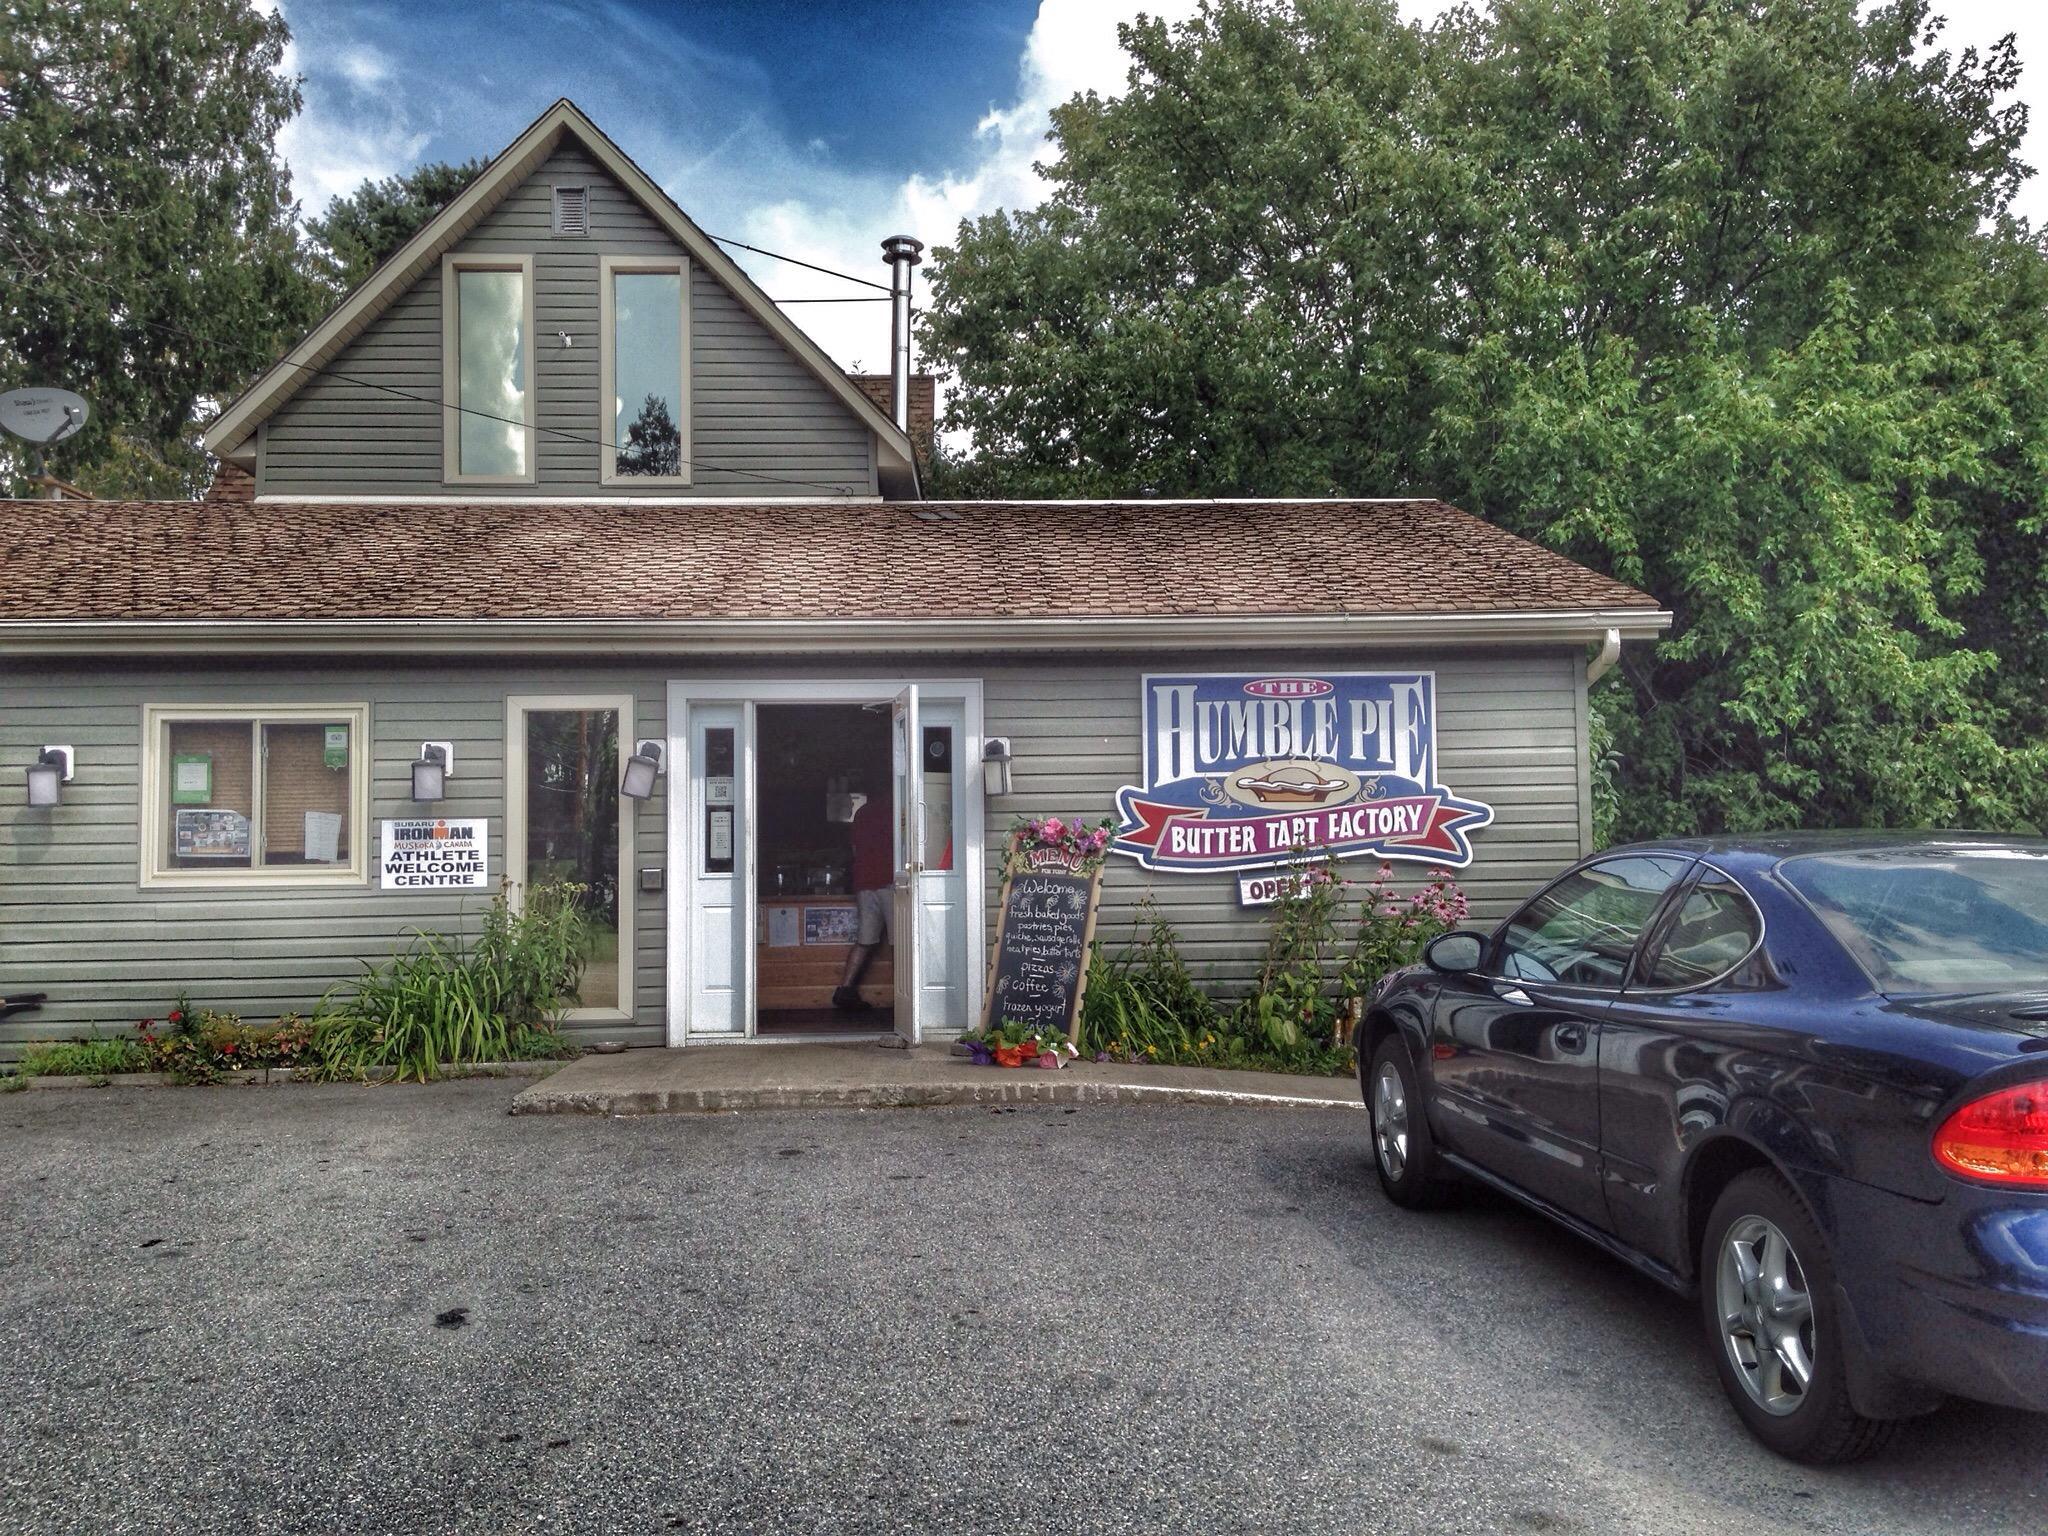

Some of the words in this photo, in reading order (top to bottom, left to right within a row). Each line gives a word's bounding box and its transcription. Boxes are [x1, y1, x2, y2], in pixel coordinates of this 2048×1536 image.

[1260, 682, 1318, 695] THE
[1153, 684, 1338, 788] HUMBLE
[1348, 676, 1428, 794] PIE
[394, 826, 474, 841] IRONMAN
[1171, 825, 1257, 855] BUTTER
[1266, 817, 1319, 850] TART
[1328, 804, 1424, 840] FACTORY
[394, 841, 435, 850] MUSKOKA
[443, 840, 473, 849] CANADA
[390, 850, 480, 861] ATHLETE
[1029, 848, 1085, 871] MENU
[385, 862, 485, 874] WELCOME
[394, 874, 475, 886] CENTRE
[1023, 878, 1075, 894] Welcome
[1009, 904, 1034, 918] fresh
[1035, 904, 1060, 919] baked
[1061, 908, 1085, 925] goods
[1020, 962, 1055, 977] pizzas
[1003, 995, 1032, 1012] frozen
[1035, 998, 1066, 1019] yogurt
